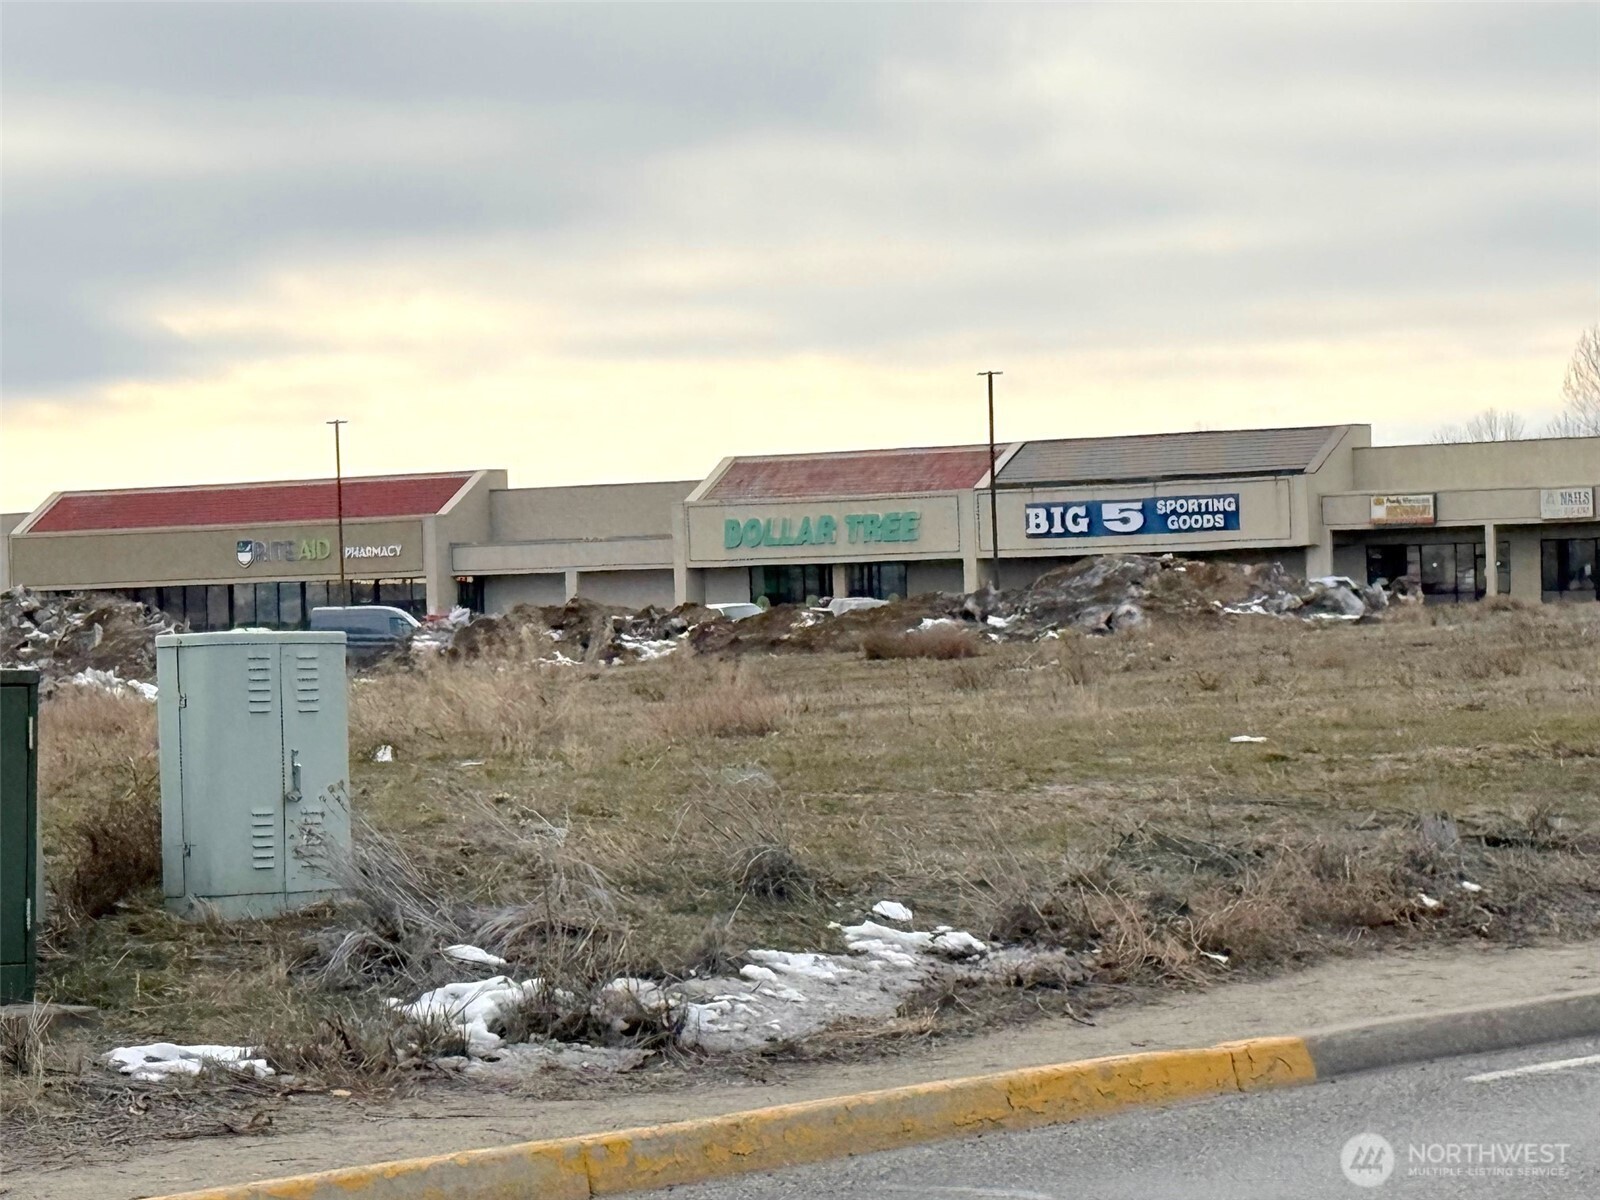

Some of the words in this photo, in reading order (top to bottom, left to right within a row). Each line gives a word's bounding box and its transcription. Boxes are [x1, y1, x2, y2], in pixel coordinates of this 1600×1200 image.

[1156, 497, 1236, 514] SPORTING
[1560, 491, 1590, 506] NAILS
[1026, 505, 1089, 534] BIG
[1102, 502, 1144, 533] 5
[1167, 513, 1224, 530] GOODS
[724, 514, 837, 549] DOLLAR
[845, 511, 921, 544] TREE
[254, 540, 296, 562] RITE
[299, 538, 332, 561] AID
[345, 544, 402, 559] PHARMACY
